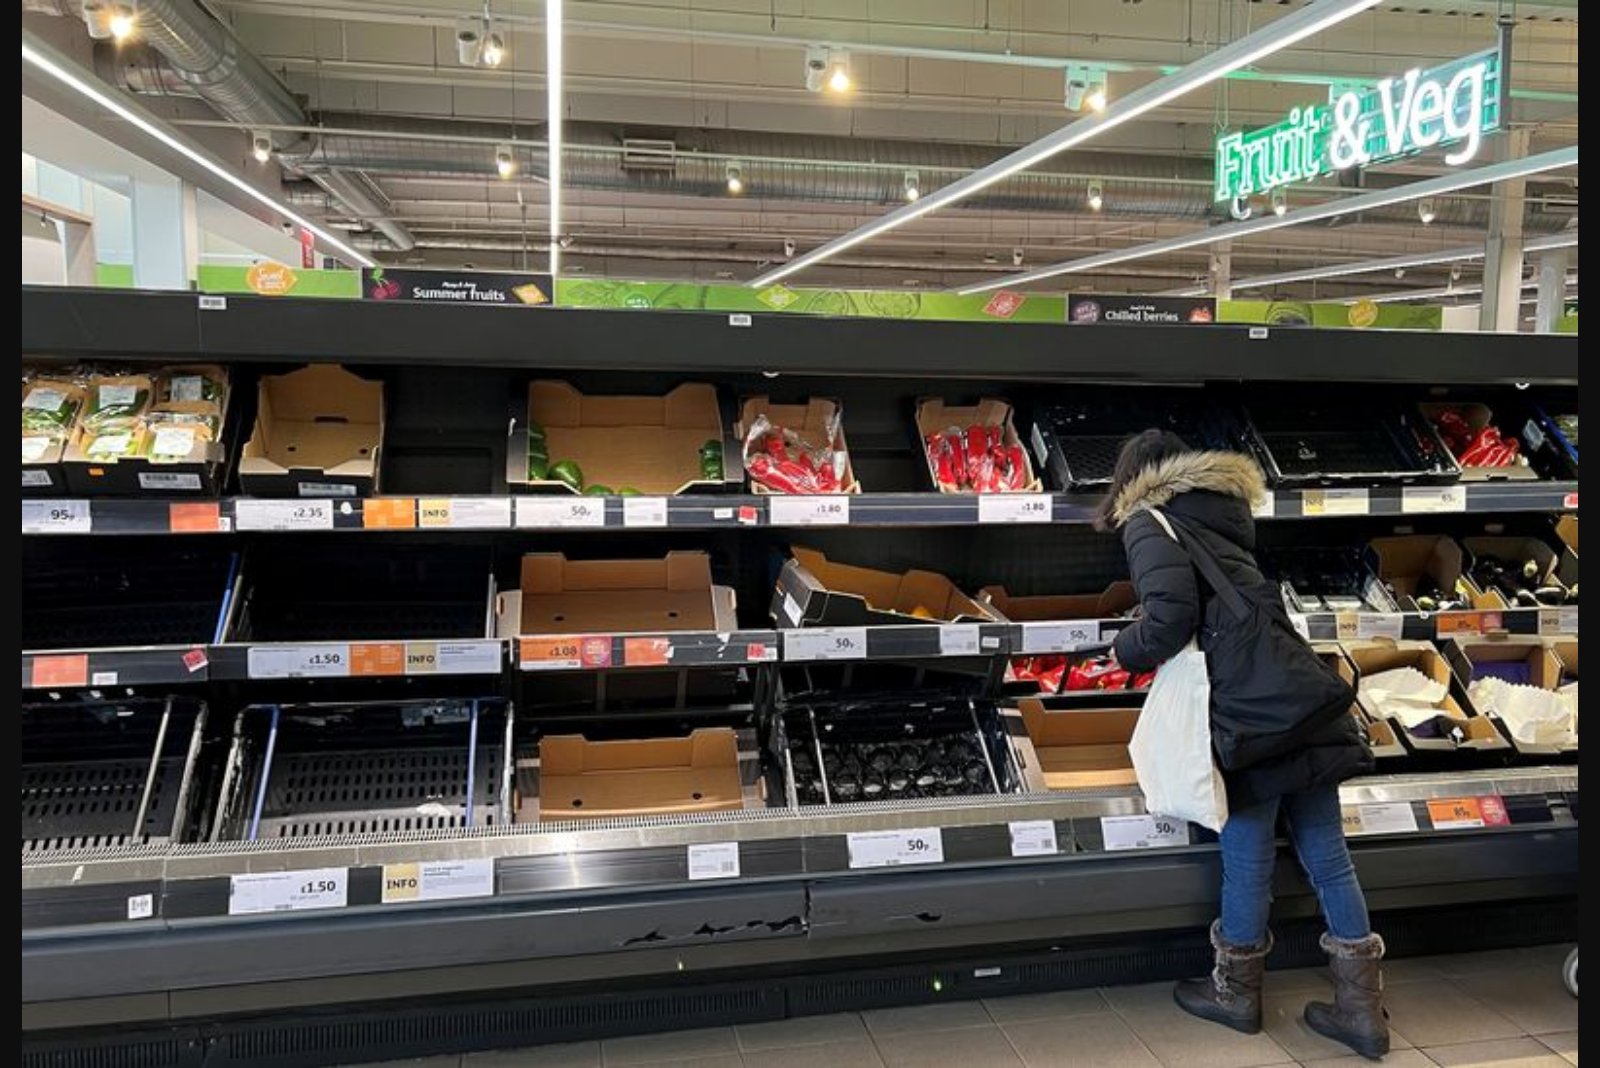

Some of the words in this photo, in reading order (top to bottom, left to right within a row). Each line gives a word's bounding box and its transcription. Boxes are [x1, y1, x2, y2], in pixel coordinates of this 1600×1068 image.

[1215, 106, 1322, 202] Fruit
[1329, 91, 1371, 169] &
[1377, 61, 1486, 166] Veg
[412, 287, 467, 300] Summer
[470, 285, 505, 302] fruits
[1104, 309, 1141, 321] Chilled
[1144, 310, 1179, 322] berries
[50, 509, 75, 521] 95p
[422, 509, 448, 518] INFO
[1069, 629, 1089, 641] 50p
[835, 637, 855, 649] 50p
[308, 653, 341, 665] £1.50
[407, 655, 436, 664] INFO
[1154, 821, 1177, 836] 50p
[907, 839, 929, 851] 50p
[300, 880, 337, 894] £1.50
[386, 879, 418, 891] INFO
